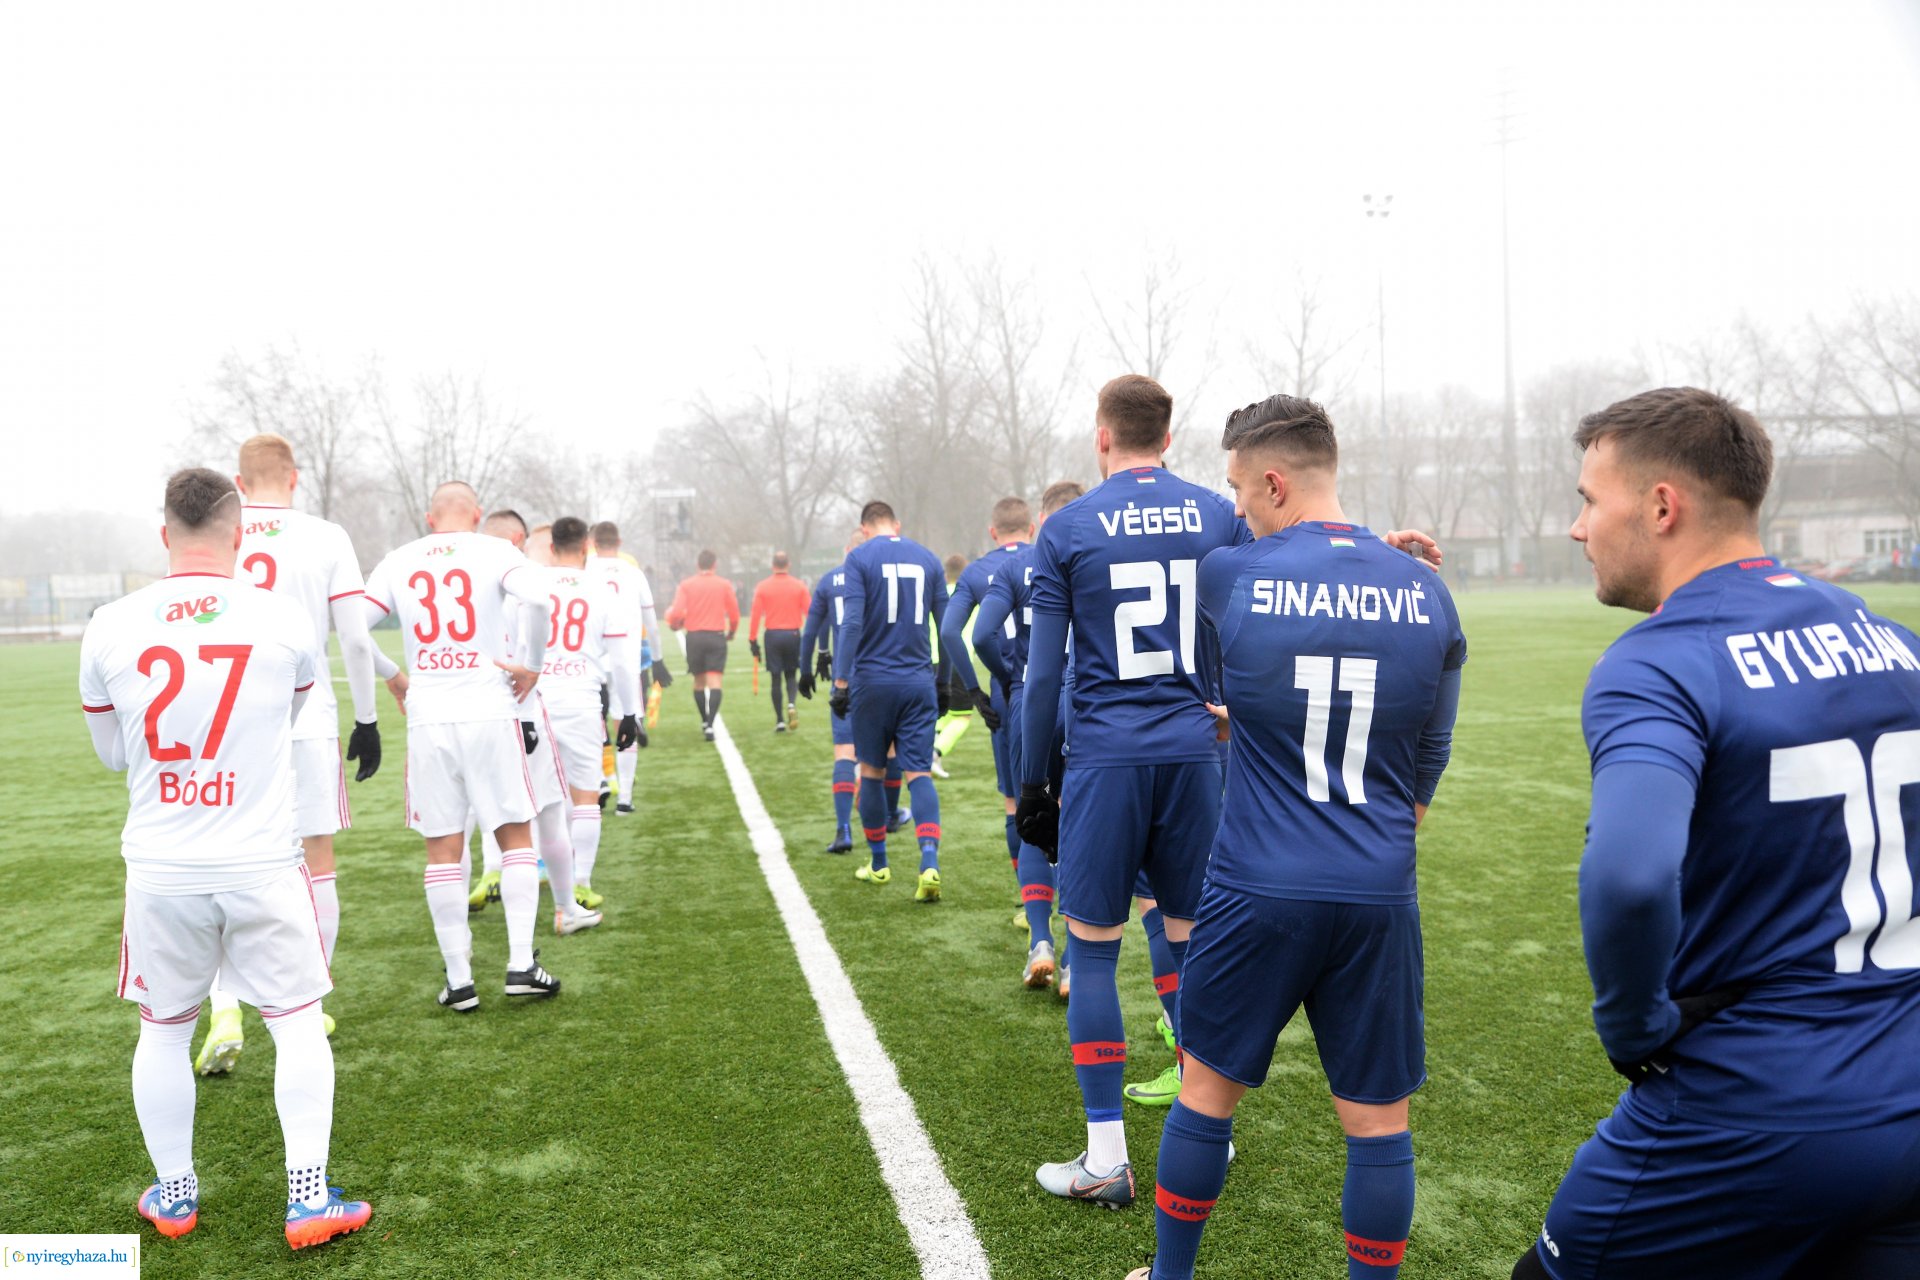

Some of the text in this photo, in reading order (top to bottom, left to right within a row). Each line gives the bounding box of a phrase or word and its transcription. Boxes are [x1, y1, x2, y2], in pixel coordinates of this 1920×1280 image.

[245, 519, 281, 535] ave
[165, 595, 219, 623] ave
[408, 568, 476, 644] 33
[882, 563, 925, 624] 17
[1109, 559, 1197, 680] 21
[1251, 580, 1430, 624] SINANOVIČ
[542, 657, 587, 676] zécsi
[1726, 609, 1920, 688] GYURJÁN
[137, 644, 254, 761] 27
[1294, 656, 1378, 804] 11
[159, 770, 235, 807] Bódi
[1348, 1240, 1393, 1260] JAKO
